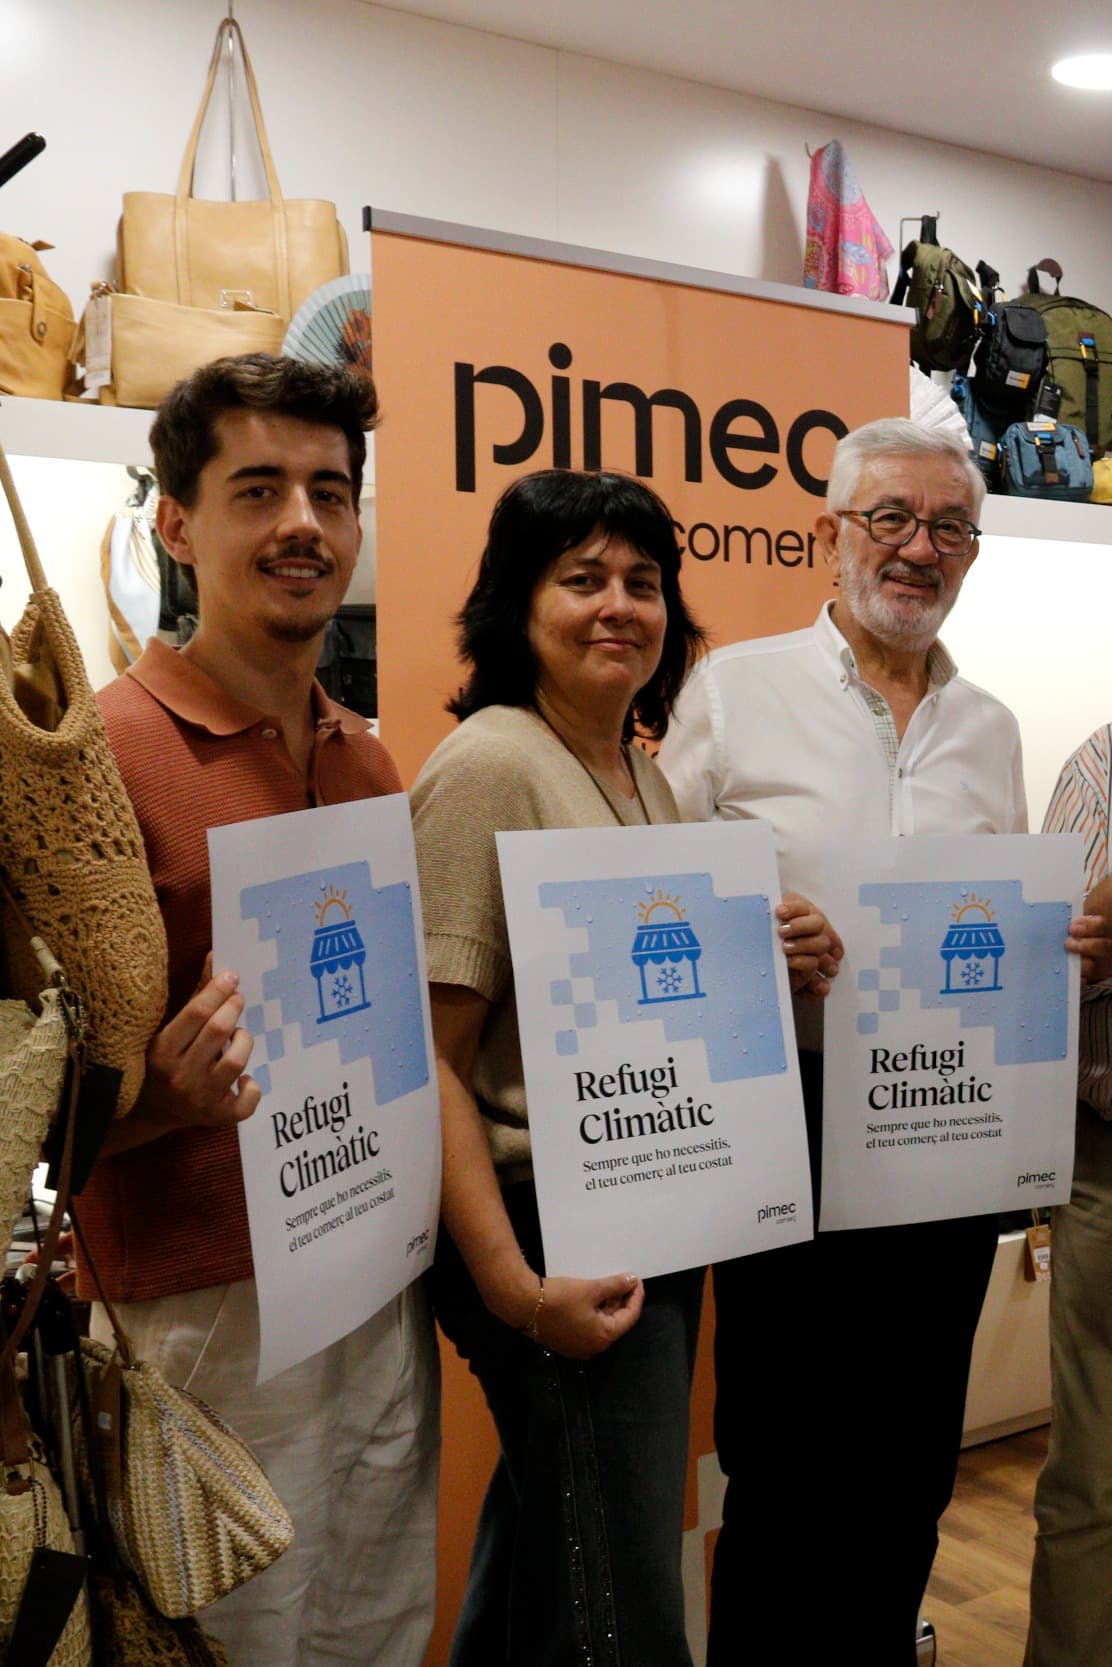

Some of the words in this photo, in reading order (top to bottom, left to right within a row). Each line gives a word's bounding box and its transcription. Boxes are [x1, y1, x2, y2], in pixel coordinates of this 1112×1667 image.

[870, 1041, 965, 1076] Refugi
[573, 1057, 678, 1101] Refugi
[868, 1076, 993, 1110] Climàtic
[270, 1082, 352, 1149] Refugi
[580, 1097, 715, 1144] Climàtic
[866, 1121, 908, 1134] Sempre
[910, 1120, 931, 1130] que
[933, 1118, 947, 1128] ho
[866, 1138, 876, 1149] el
[878, 1137, 895, 1147] teu
[897, 1134, 938, 1146] comerç
[939, 1132, 950, 1142] al
[952, 1131, 969, 1141] teu
[970, 1128, 1002, 1140] costat
[280, 1126, 381, 1198] Climàtic
[583, 1156, 629, 1172] Sempre
[632, 1153, 653, 1166] que
[655, 1148, 671, 1160] ho
[585, 1178, 597, 1191] el
[598, 1174, 617, 1188] teu
[619, 1168, 664, 1185] comerç
[666, 1164, 677, 1177] al
[678, 1161, 697, 1174] teu
[699, 1155, 733, 1170] costat
[1017, 1171, 1056, 1187] pimec
[285, 1204, 318, 1231] Sempre
[320, 1196, 336, 1214] que
[336, 1189, 349, 1204] ho
[289, 1240, 297, 1252] el
[297, 1231, 313, 1247] teu
[313, 1217, 344, 1240] comerç
[346, 1207, 354, 1222] al
[354, 1200, 369, 1218] teu
[370, 1188, 395, 1208] costat
[757, 1202, 796, 1223] pimec
